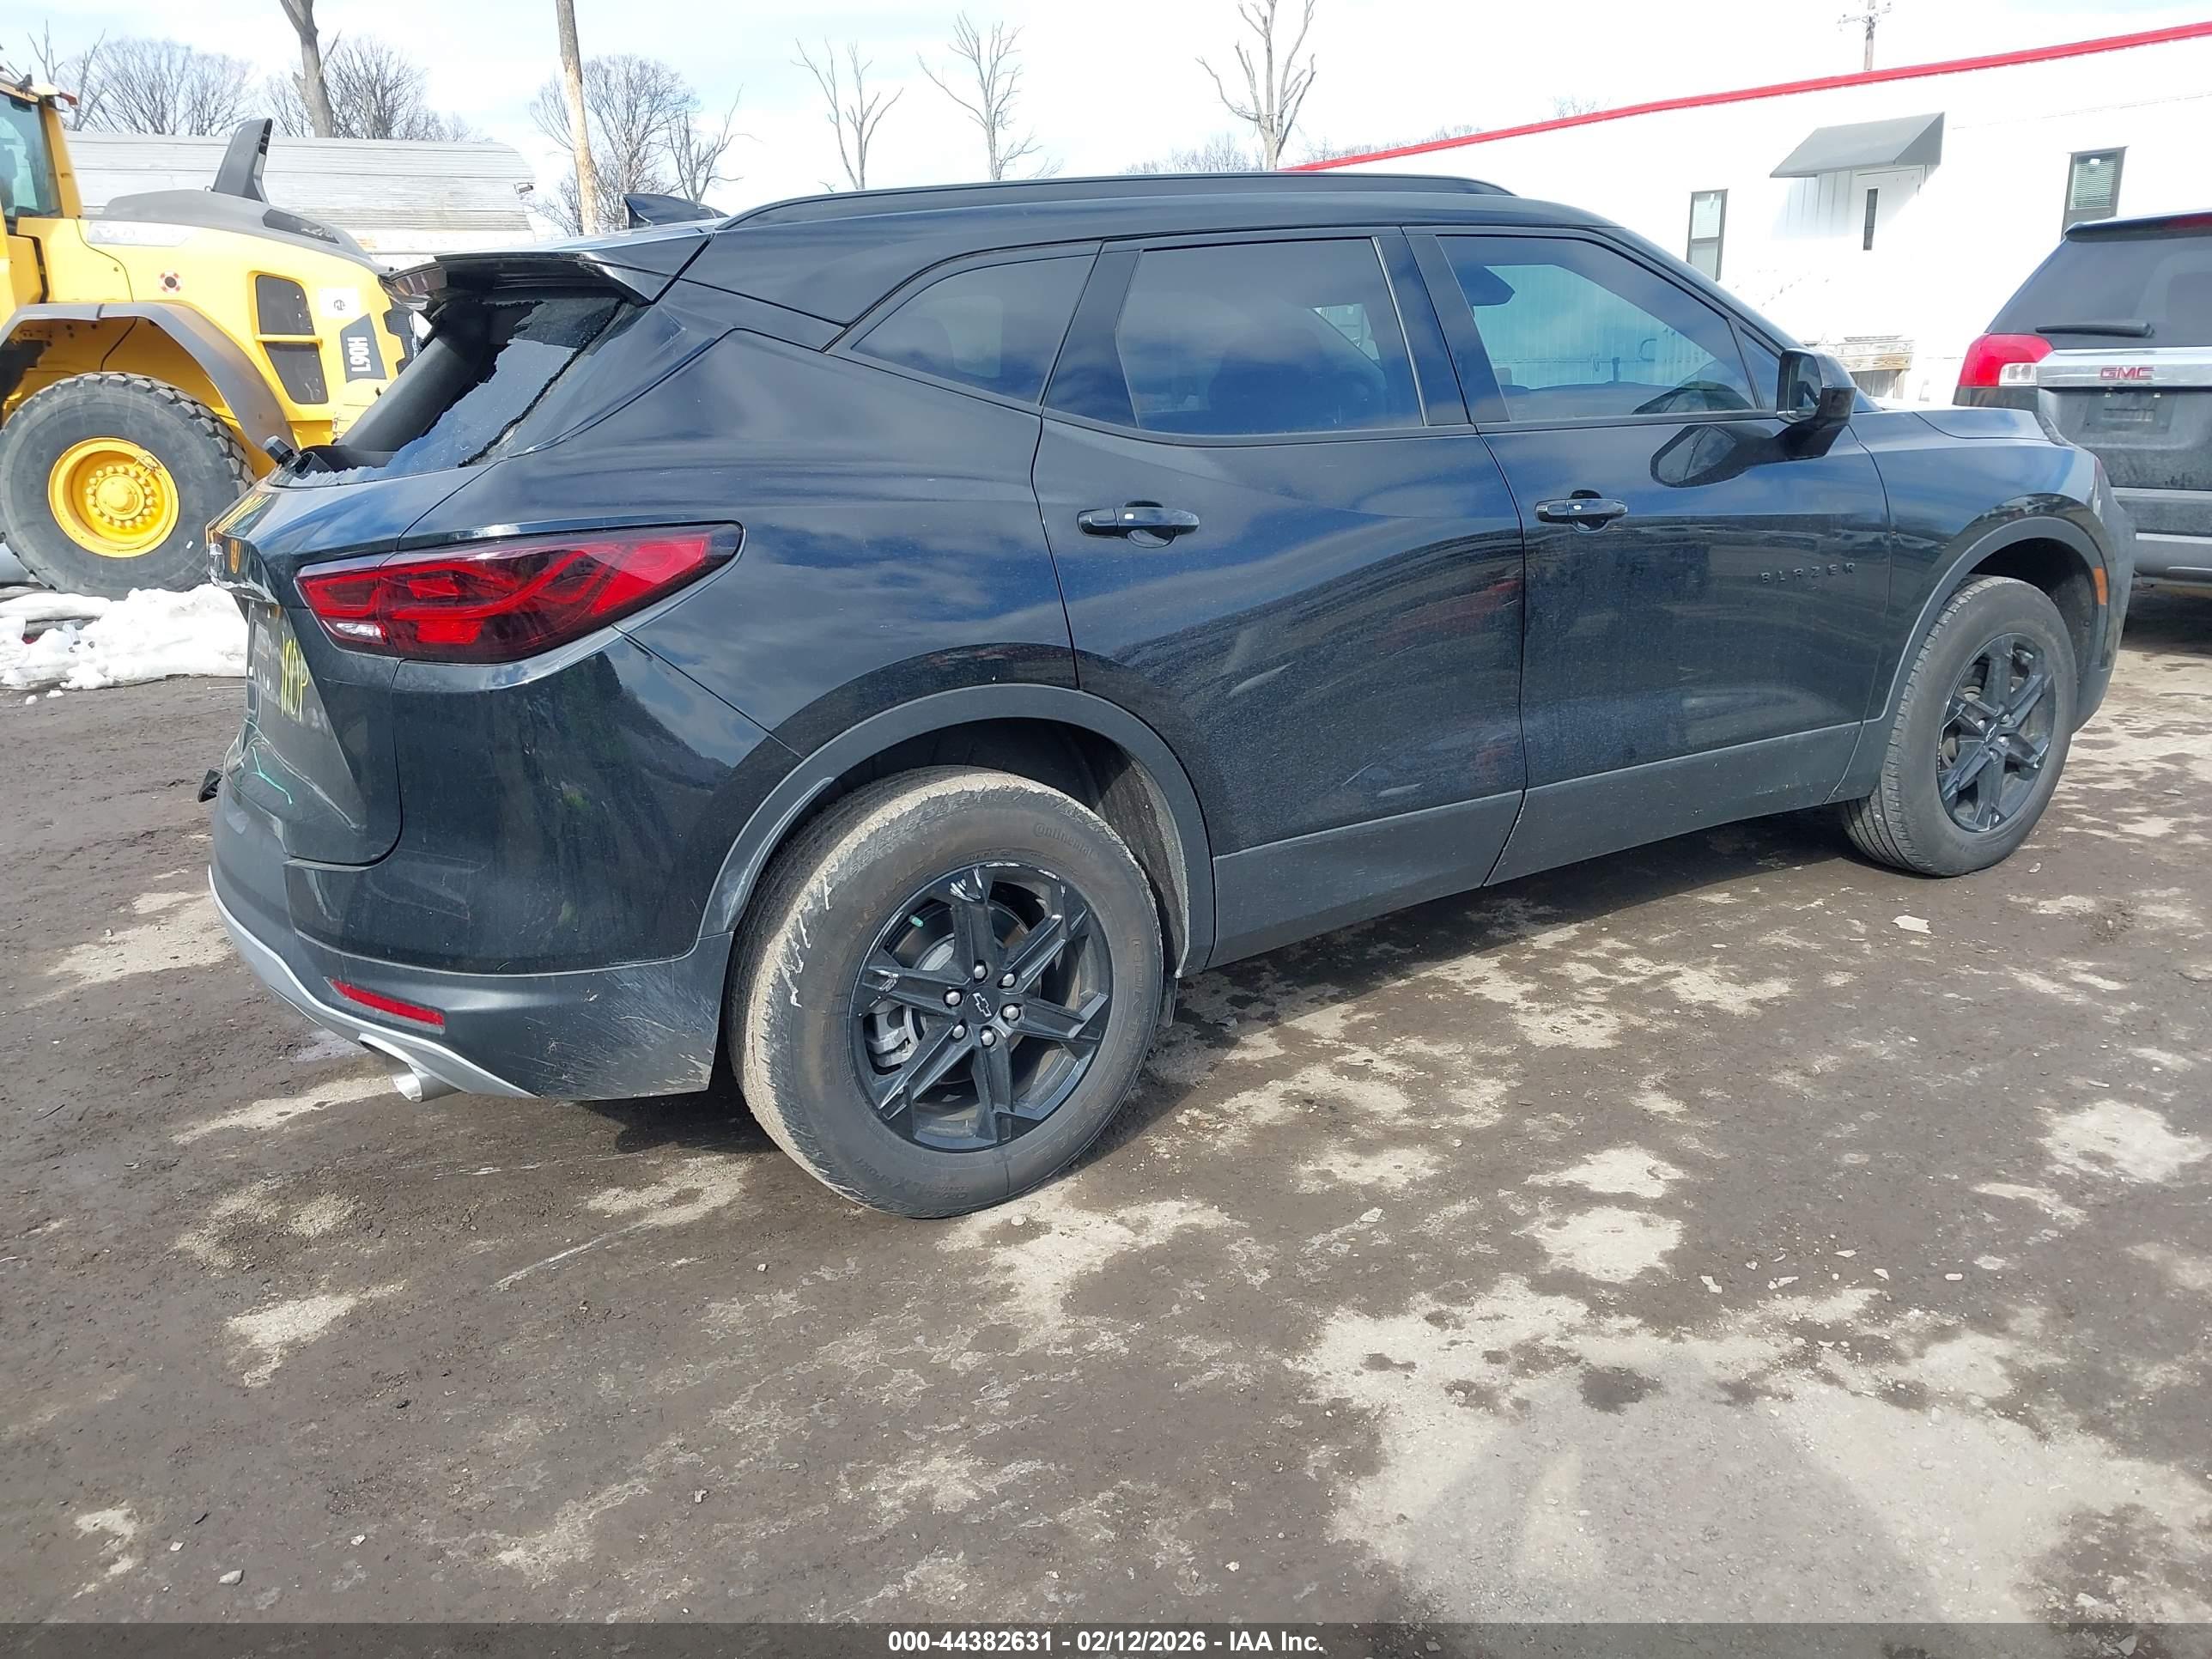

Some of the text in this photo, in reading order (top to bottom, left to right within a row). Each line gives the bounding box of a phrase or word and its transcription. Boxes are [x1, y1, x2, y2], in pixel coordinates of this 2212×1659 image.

[346, 336, 372, 372] L90H
[2098, 366, 2155, 380] GMC
[1758, 562, 1856, 584] BLAZER
